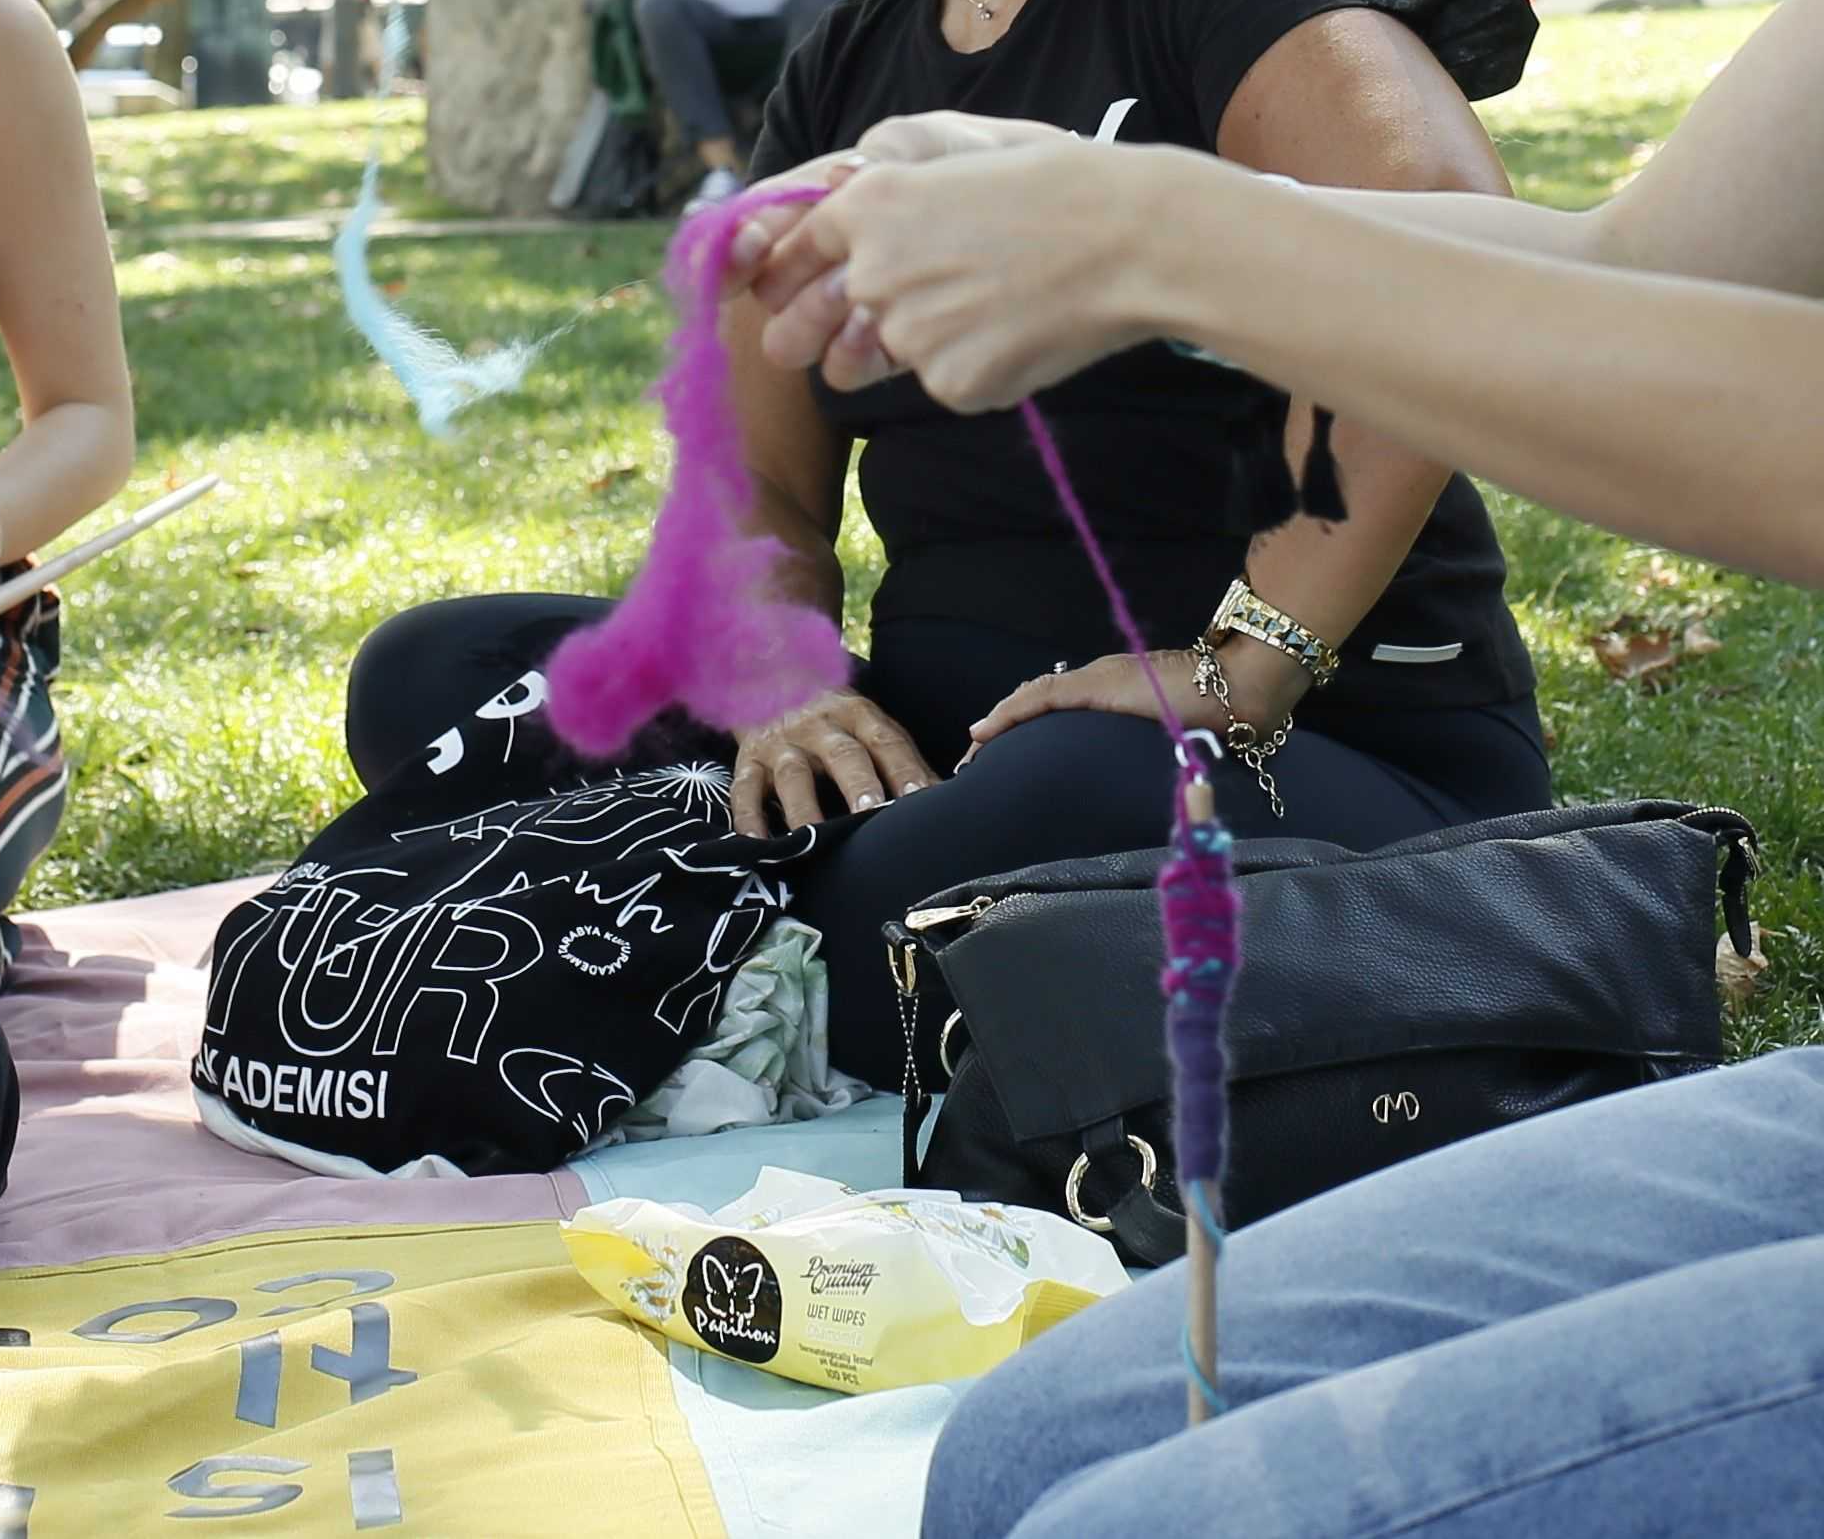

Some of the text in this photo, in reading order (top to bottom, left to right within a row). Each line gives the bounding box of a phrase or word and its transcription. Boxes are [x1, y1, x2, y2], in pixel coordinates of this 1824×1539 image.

[801, 1254, 879, 1278] Premium
[810, 1270, 873, 1295] Quality
[807, 1302, 867, 1327] WET WIPES
